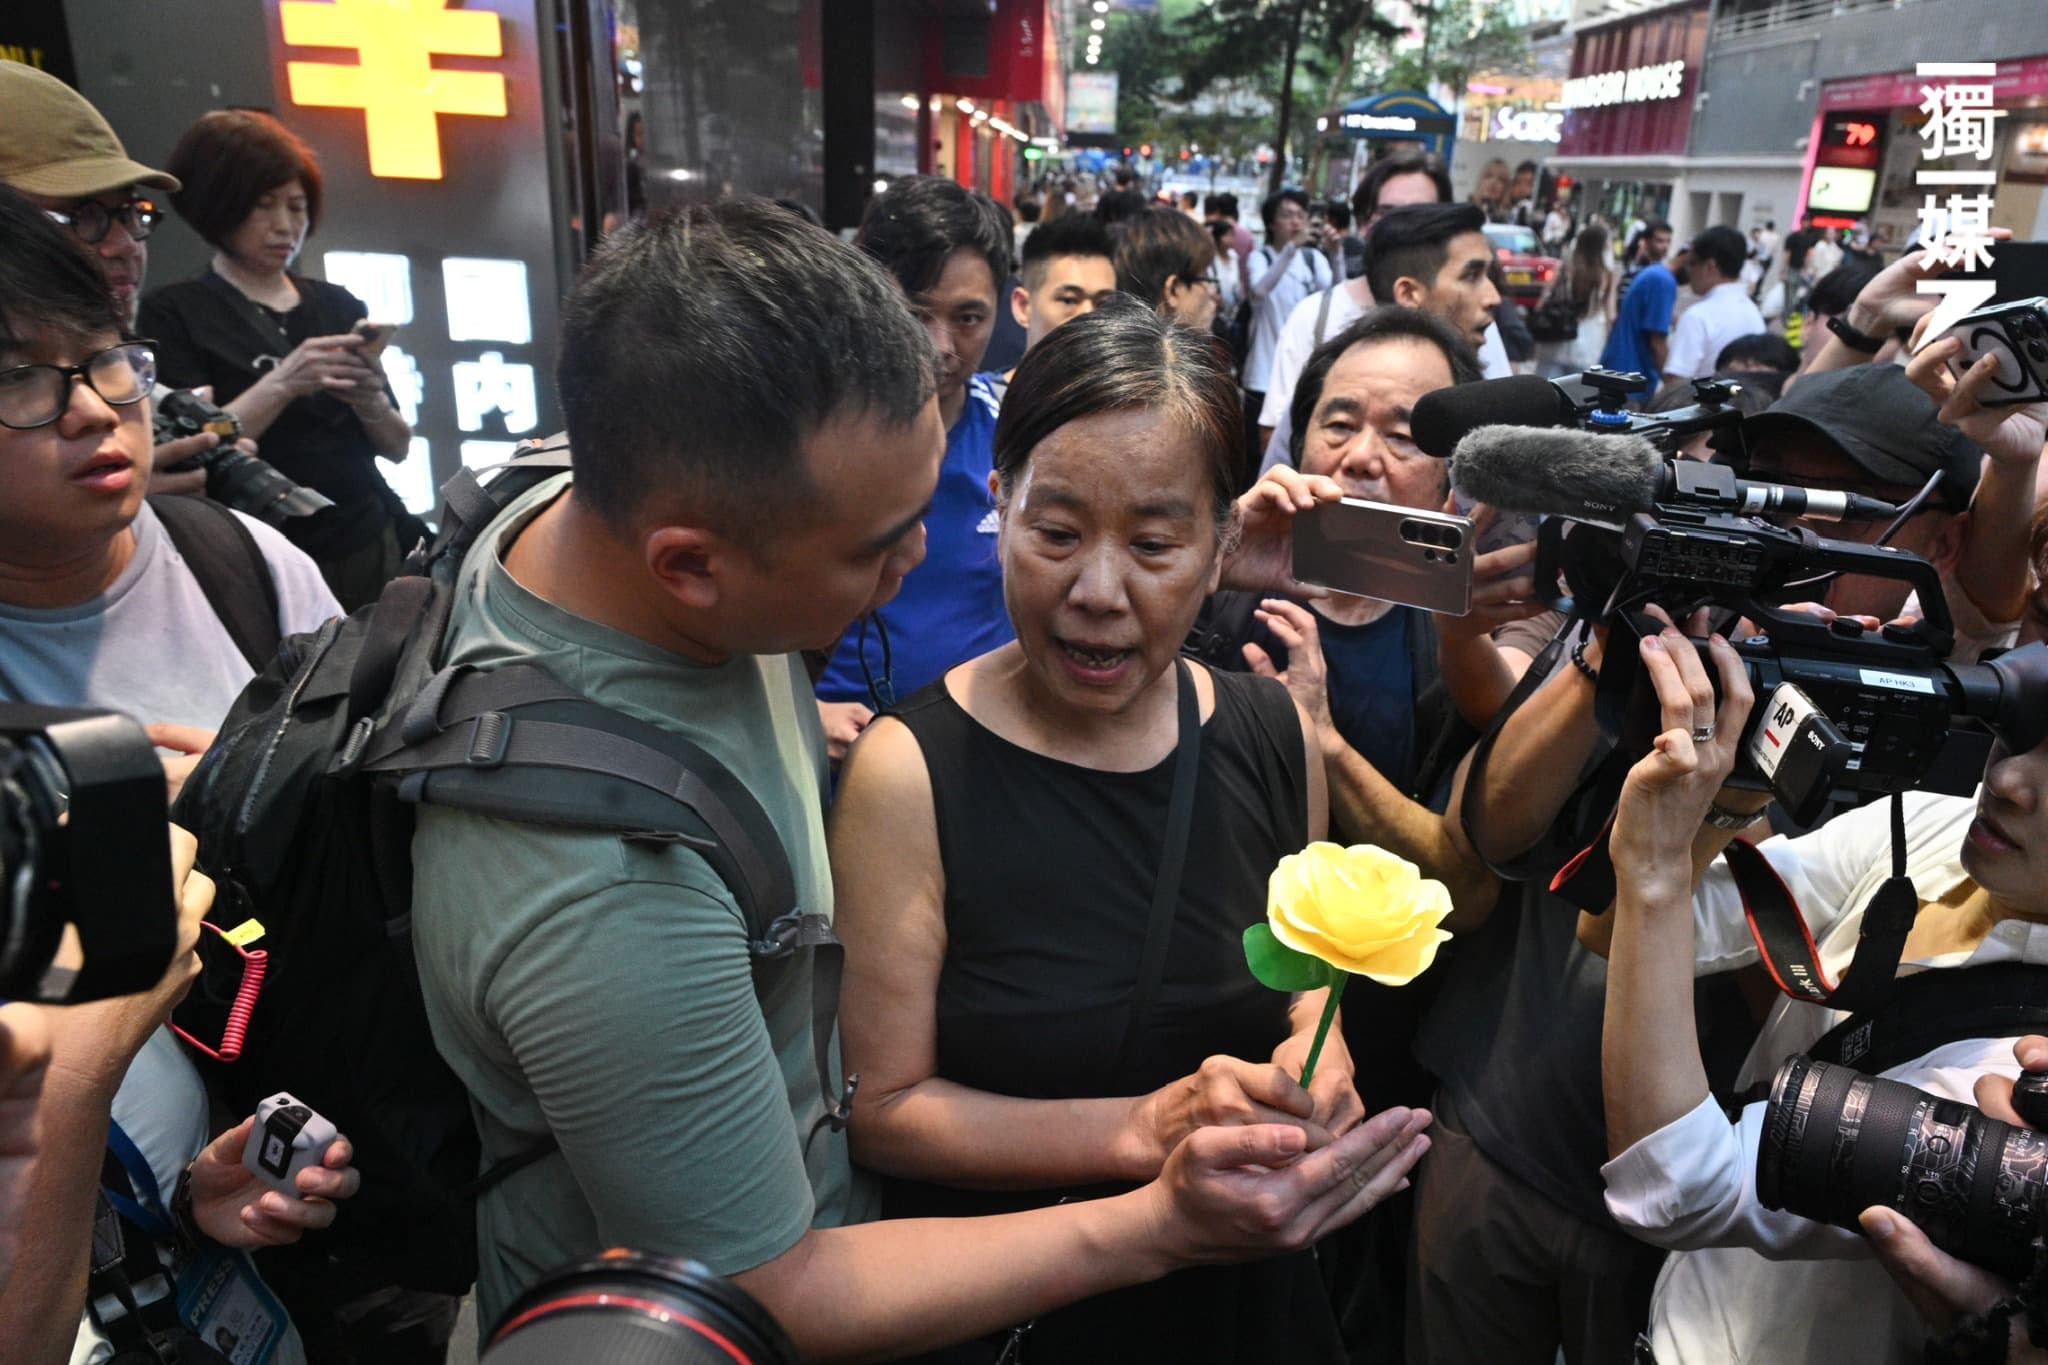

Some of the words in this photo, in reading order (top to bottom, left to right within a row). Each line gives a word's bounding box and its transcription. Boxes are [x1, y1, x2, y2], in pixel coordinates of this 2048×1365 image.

[1583, 500, 1616, 512] SONY
[1773, 702, 1795, 728] AP
[1807, 730, 1826, 751] SONY
[190, 1260, 233, 1326] PRESS
